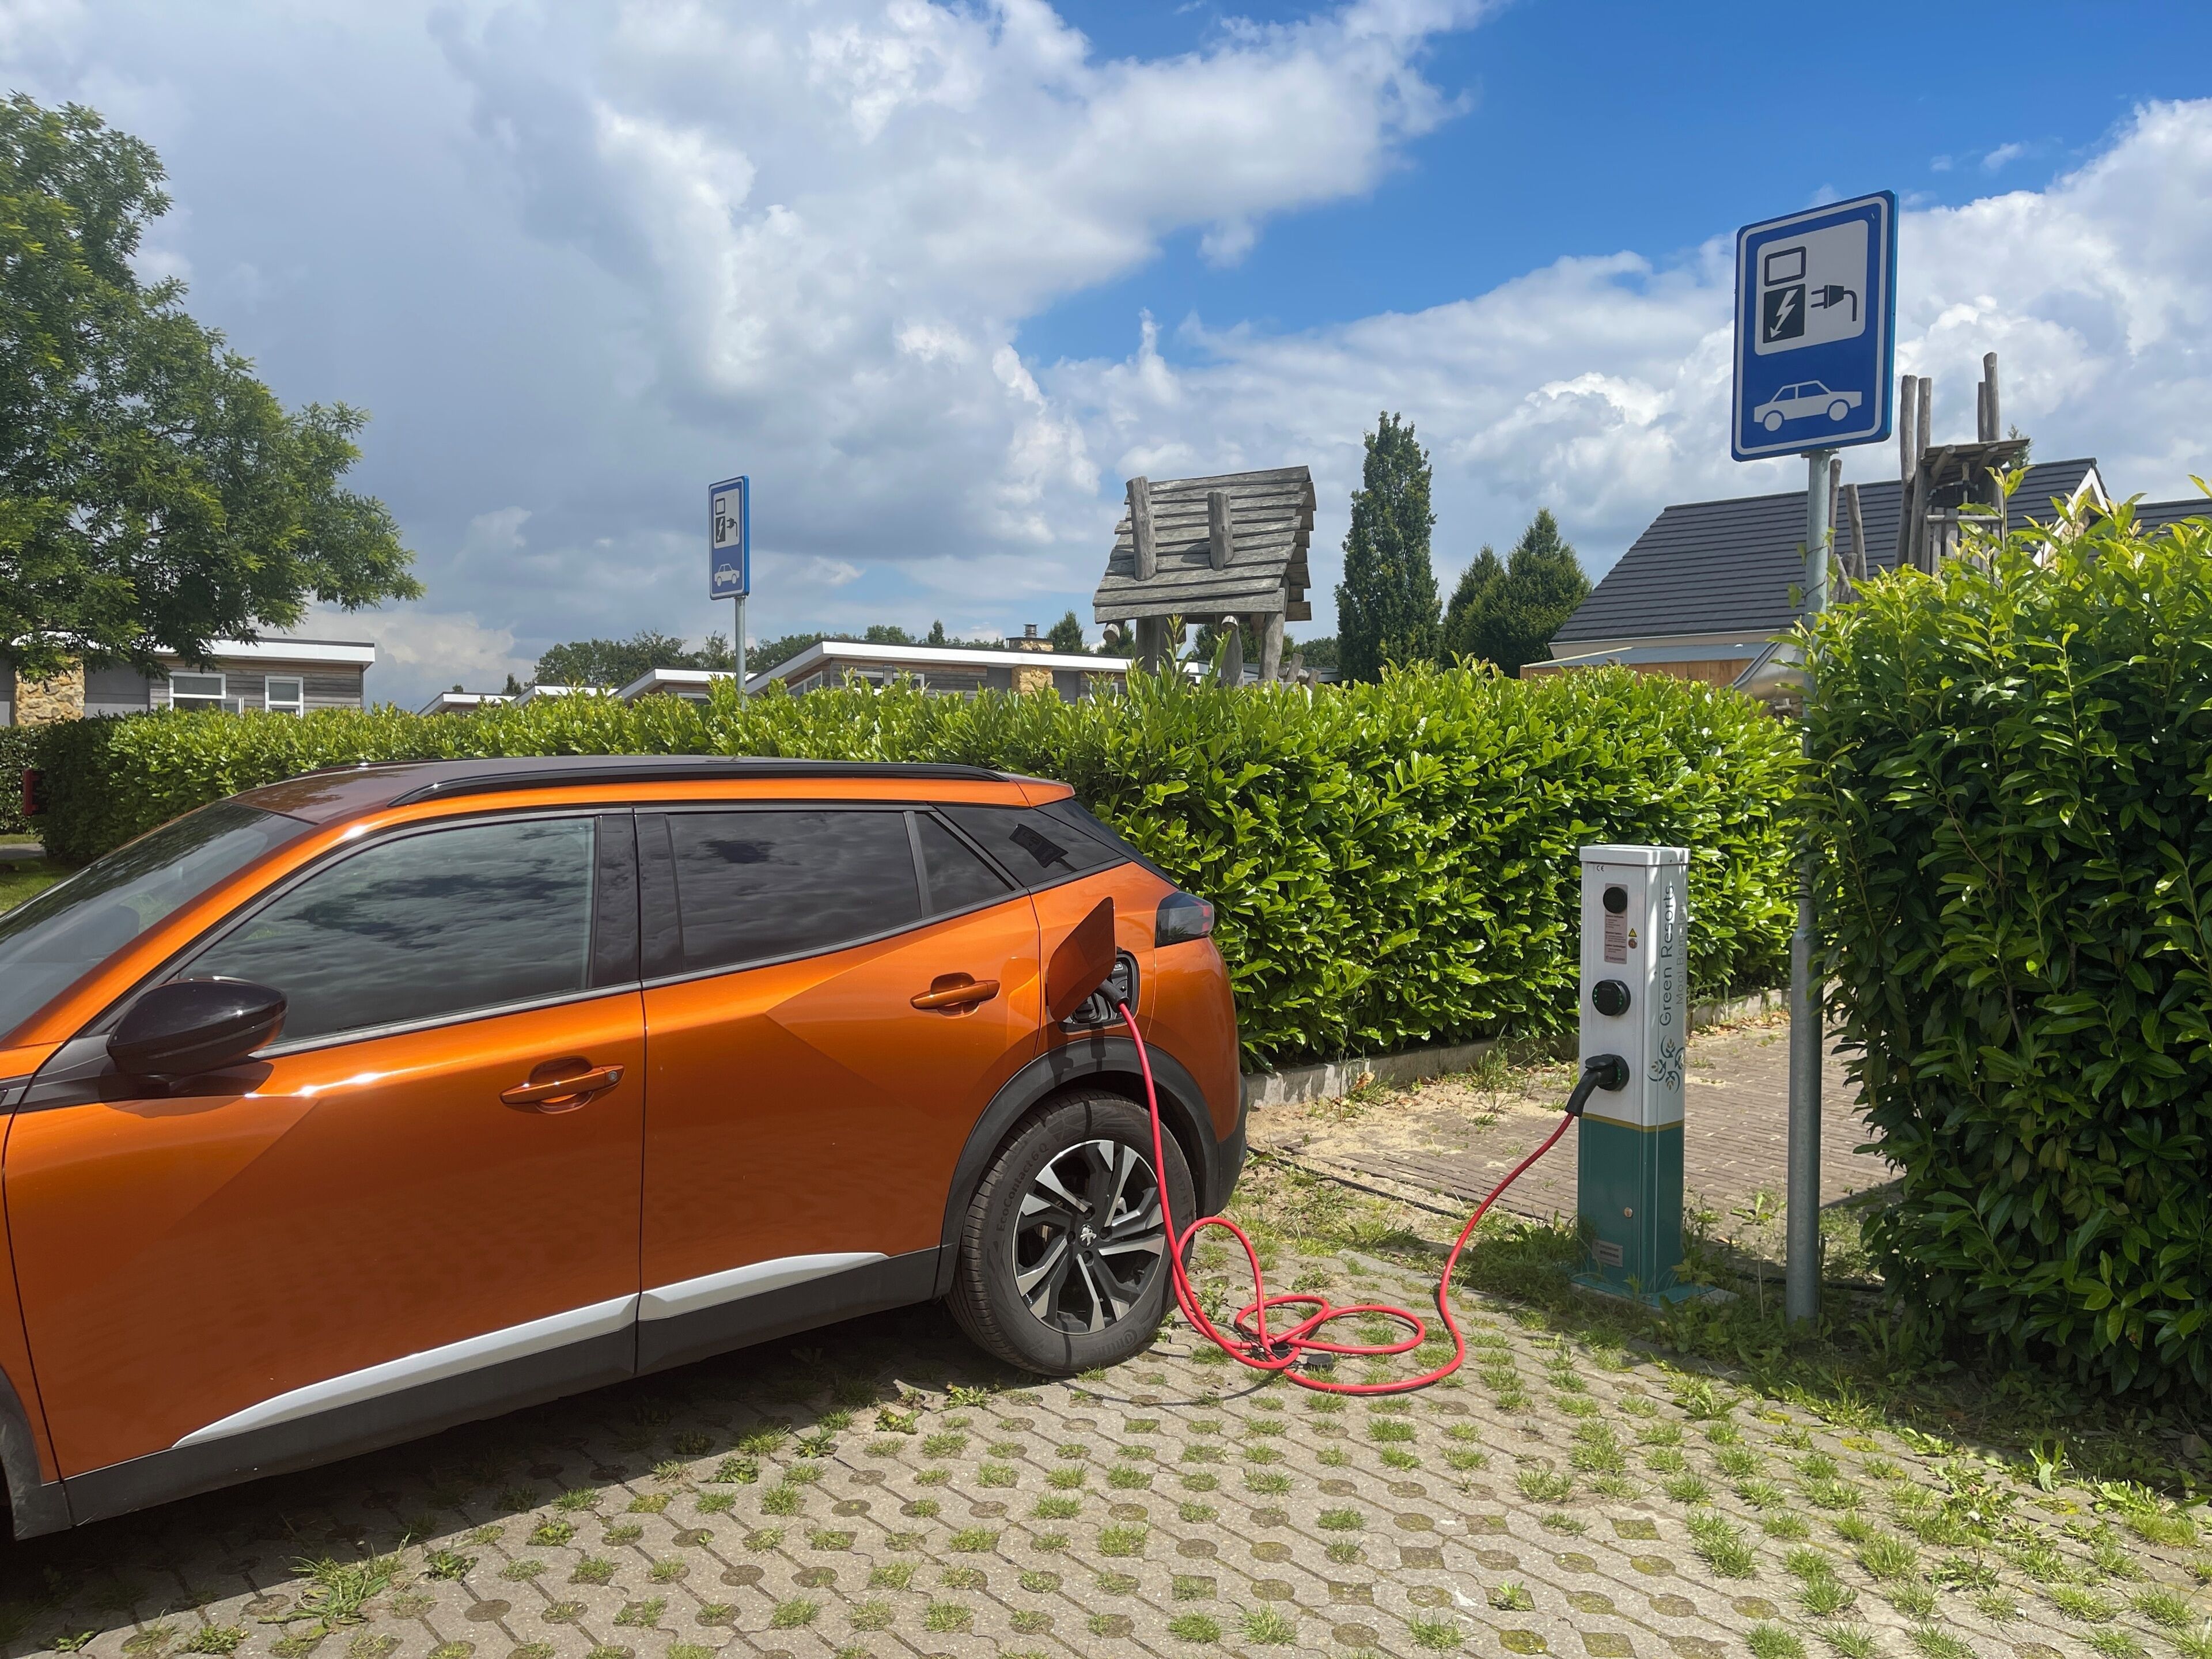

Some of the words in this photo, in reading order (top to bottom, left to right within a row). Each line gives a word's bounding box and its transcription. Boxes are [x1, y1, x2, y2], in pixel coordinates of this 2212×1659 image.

[1660, 885, 1675, 958] Resorts
[1676, 903, 1685, 965] Bemelen
[1660, 967, 1672, 1027] Green
[996, 1160, 1034, 1232] EcoContact
[1031, 1151, 1040, 1161] 6
[1039, 1142, 1050, 1153] Q
